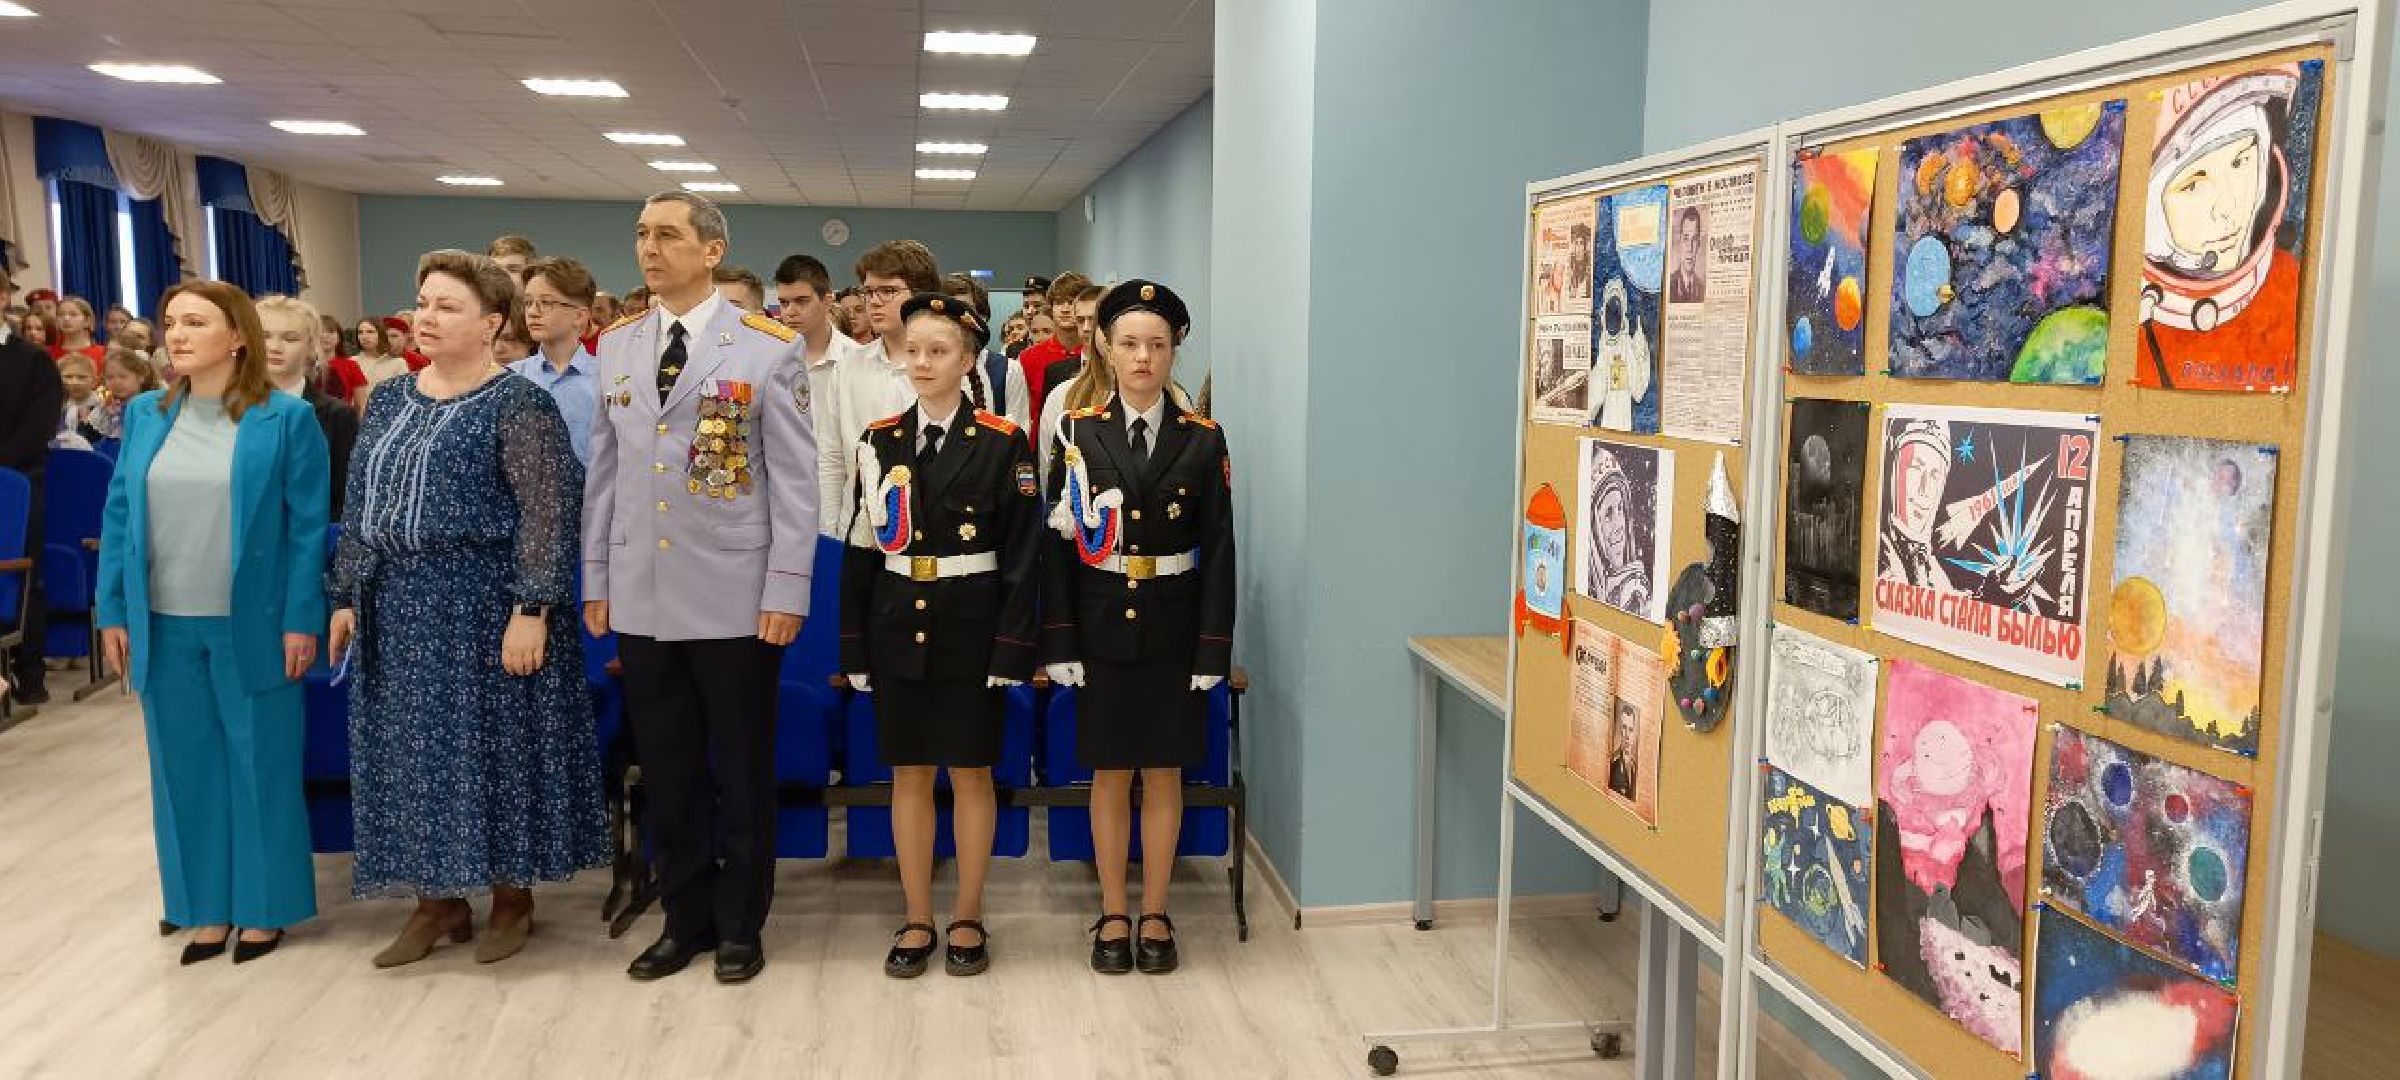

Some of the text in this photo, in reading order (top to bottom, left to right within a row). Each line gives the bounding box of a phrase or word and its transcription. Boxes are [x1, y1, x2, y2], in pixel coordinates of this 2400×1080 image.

[2057, 434, 2091, 480] 12
[1968, 488, 1998, 521] 1961
[2057, 486, 2085, 617] АПРЕЛЯ
[1875, 578, 2082, 661] СКАЗКА СТАЛА БЫЛЬЮ
